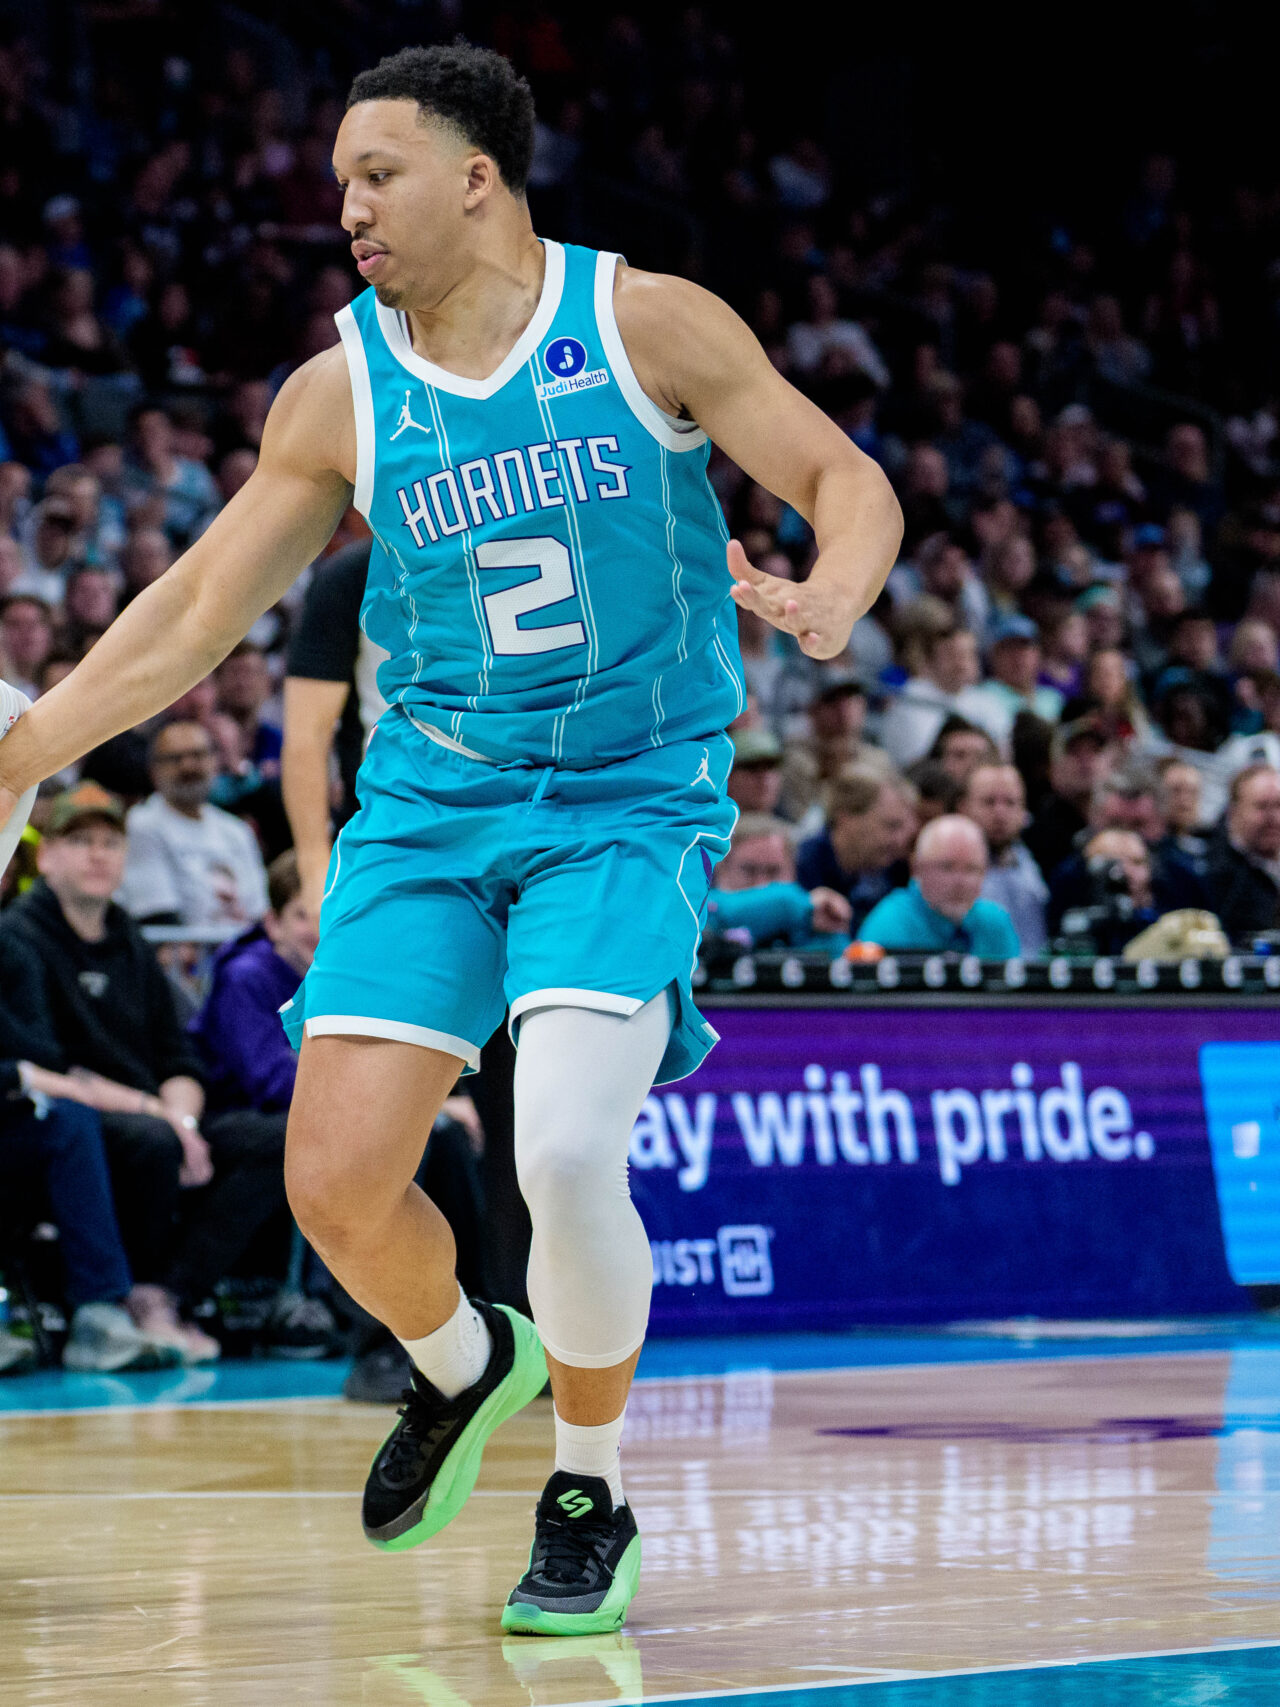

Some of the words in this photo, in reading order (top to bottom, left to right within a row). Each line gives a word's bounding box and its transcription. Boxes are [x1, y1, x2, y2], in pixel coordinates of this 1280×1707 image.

[540, 381, 568, 398] Judi
[569, 371, 607, 391] Health
[397, 435, 632, 549] HORNETS
[473, 535, 587, 656] 2
[731, 1062, 919, 1167] with
[930, 1061, 1155, 1187] pride.
